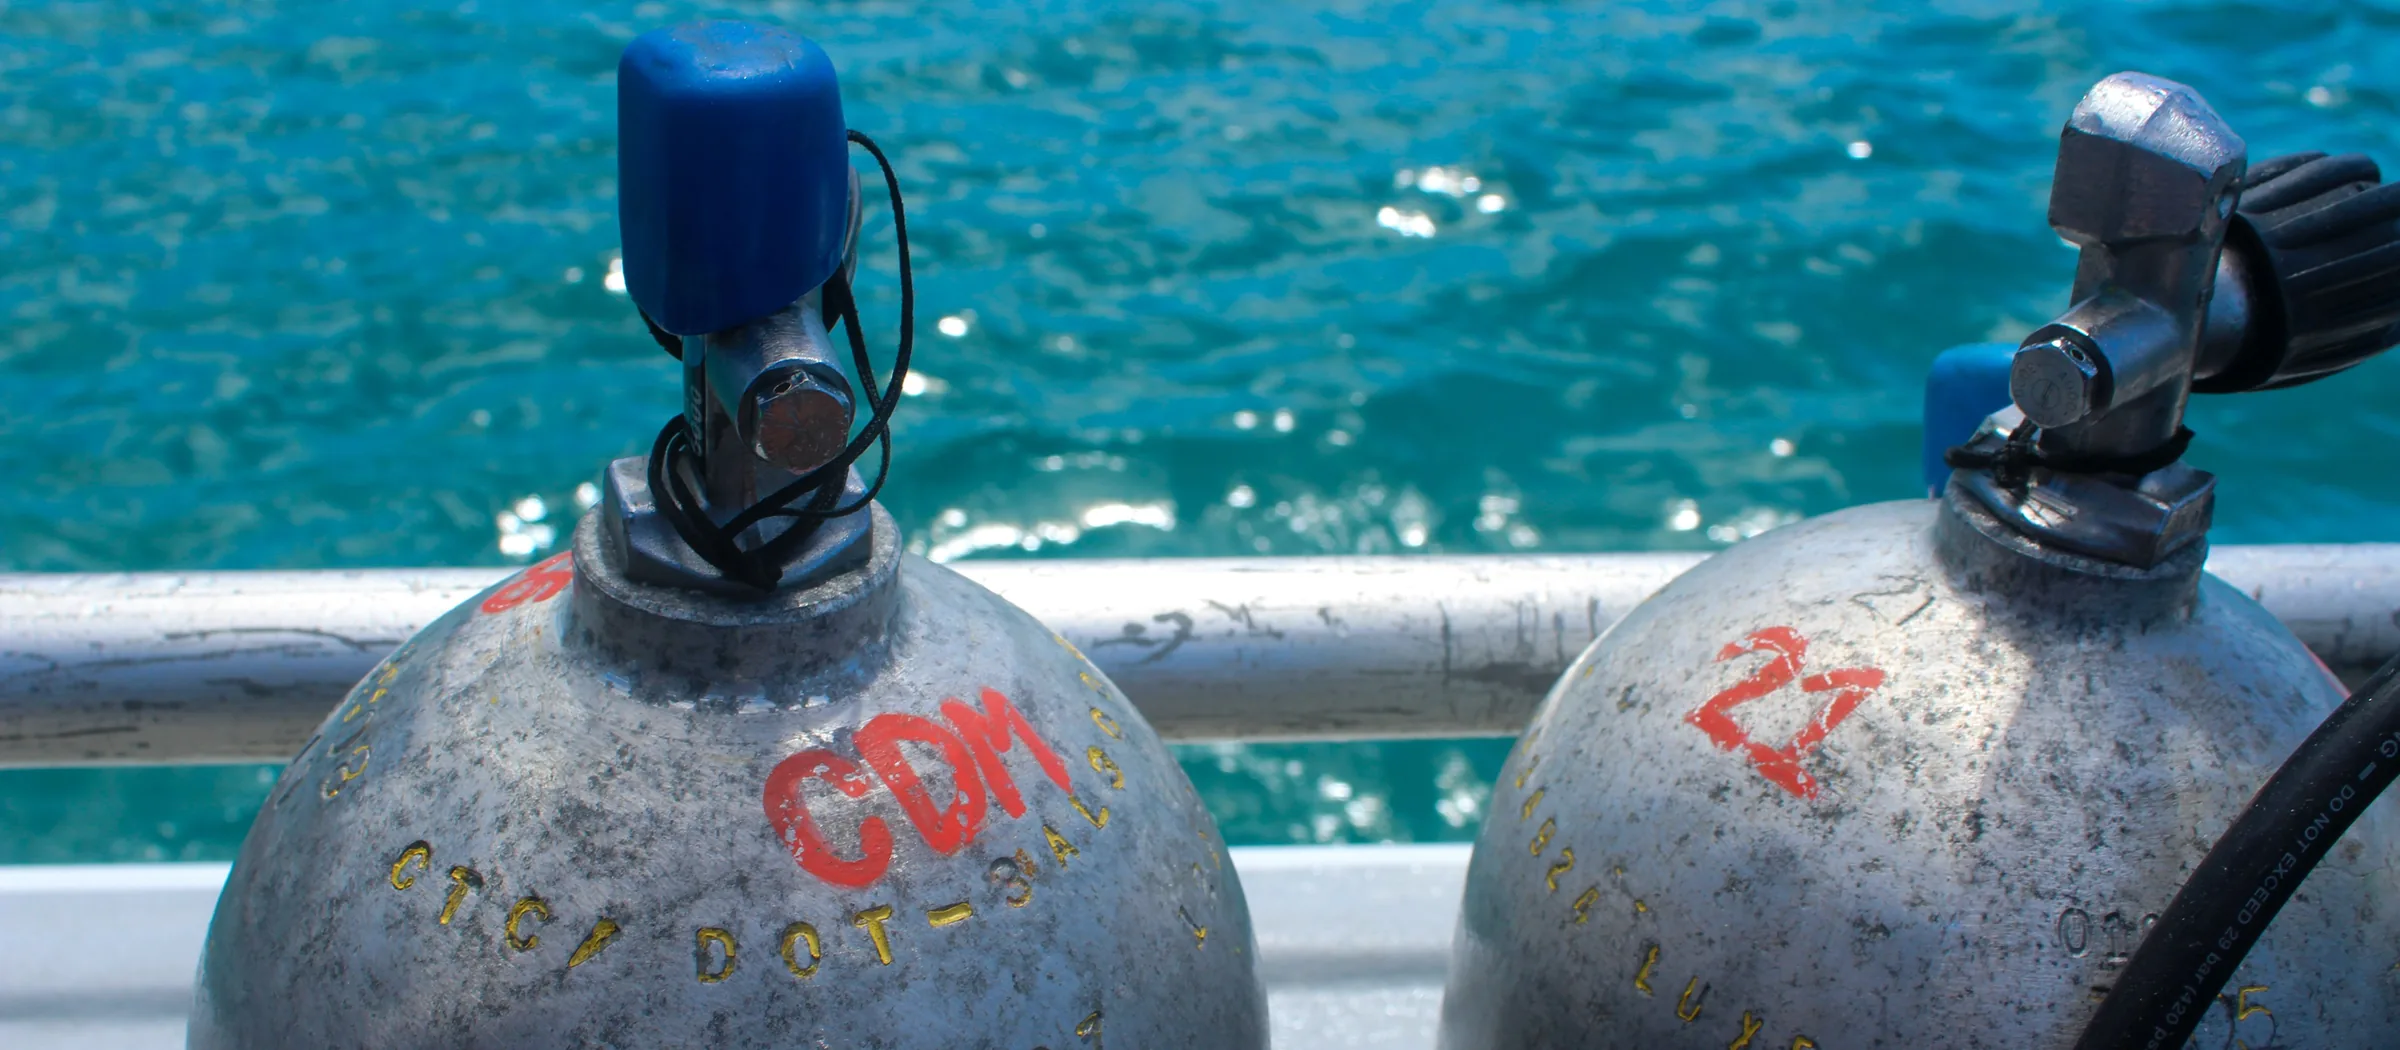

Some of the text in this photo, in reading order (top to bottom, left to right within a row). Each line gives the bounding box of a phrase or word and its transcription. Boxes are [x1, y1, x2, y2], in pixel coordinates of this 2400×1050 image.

[763, 686, 1073, 888] CDM
[2329, 784, 2356, 812] DO
[2295, 812, 2331, 854] NOT
[2237, 852, 2297, 925] EXCEED
[2218, 926, 2240, 950] 29
[2193, 953, 2222, 983] bar
